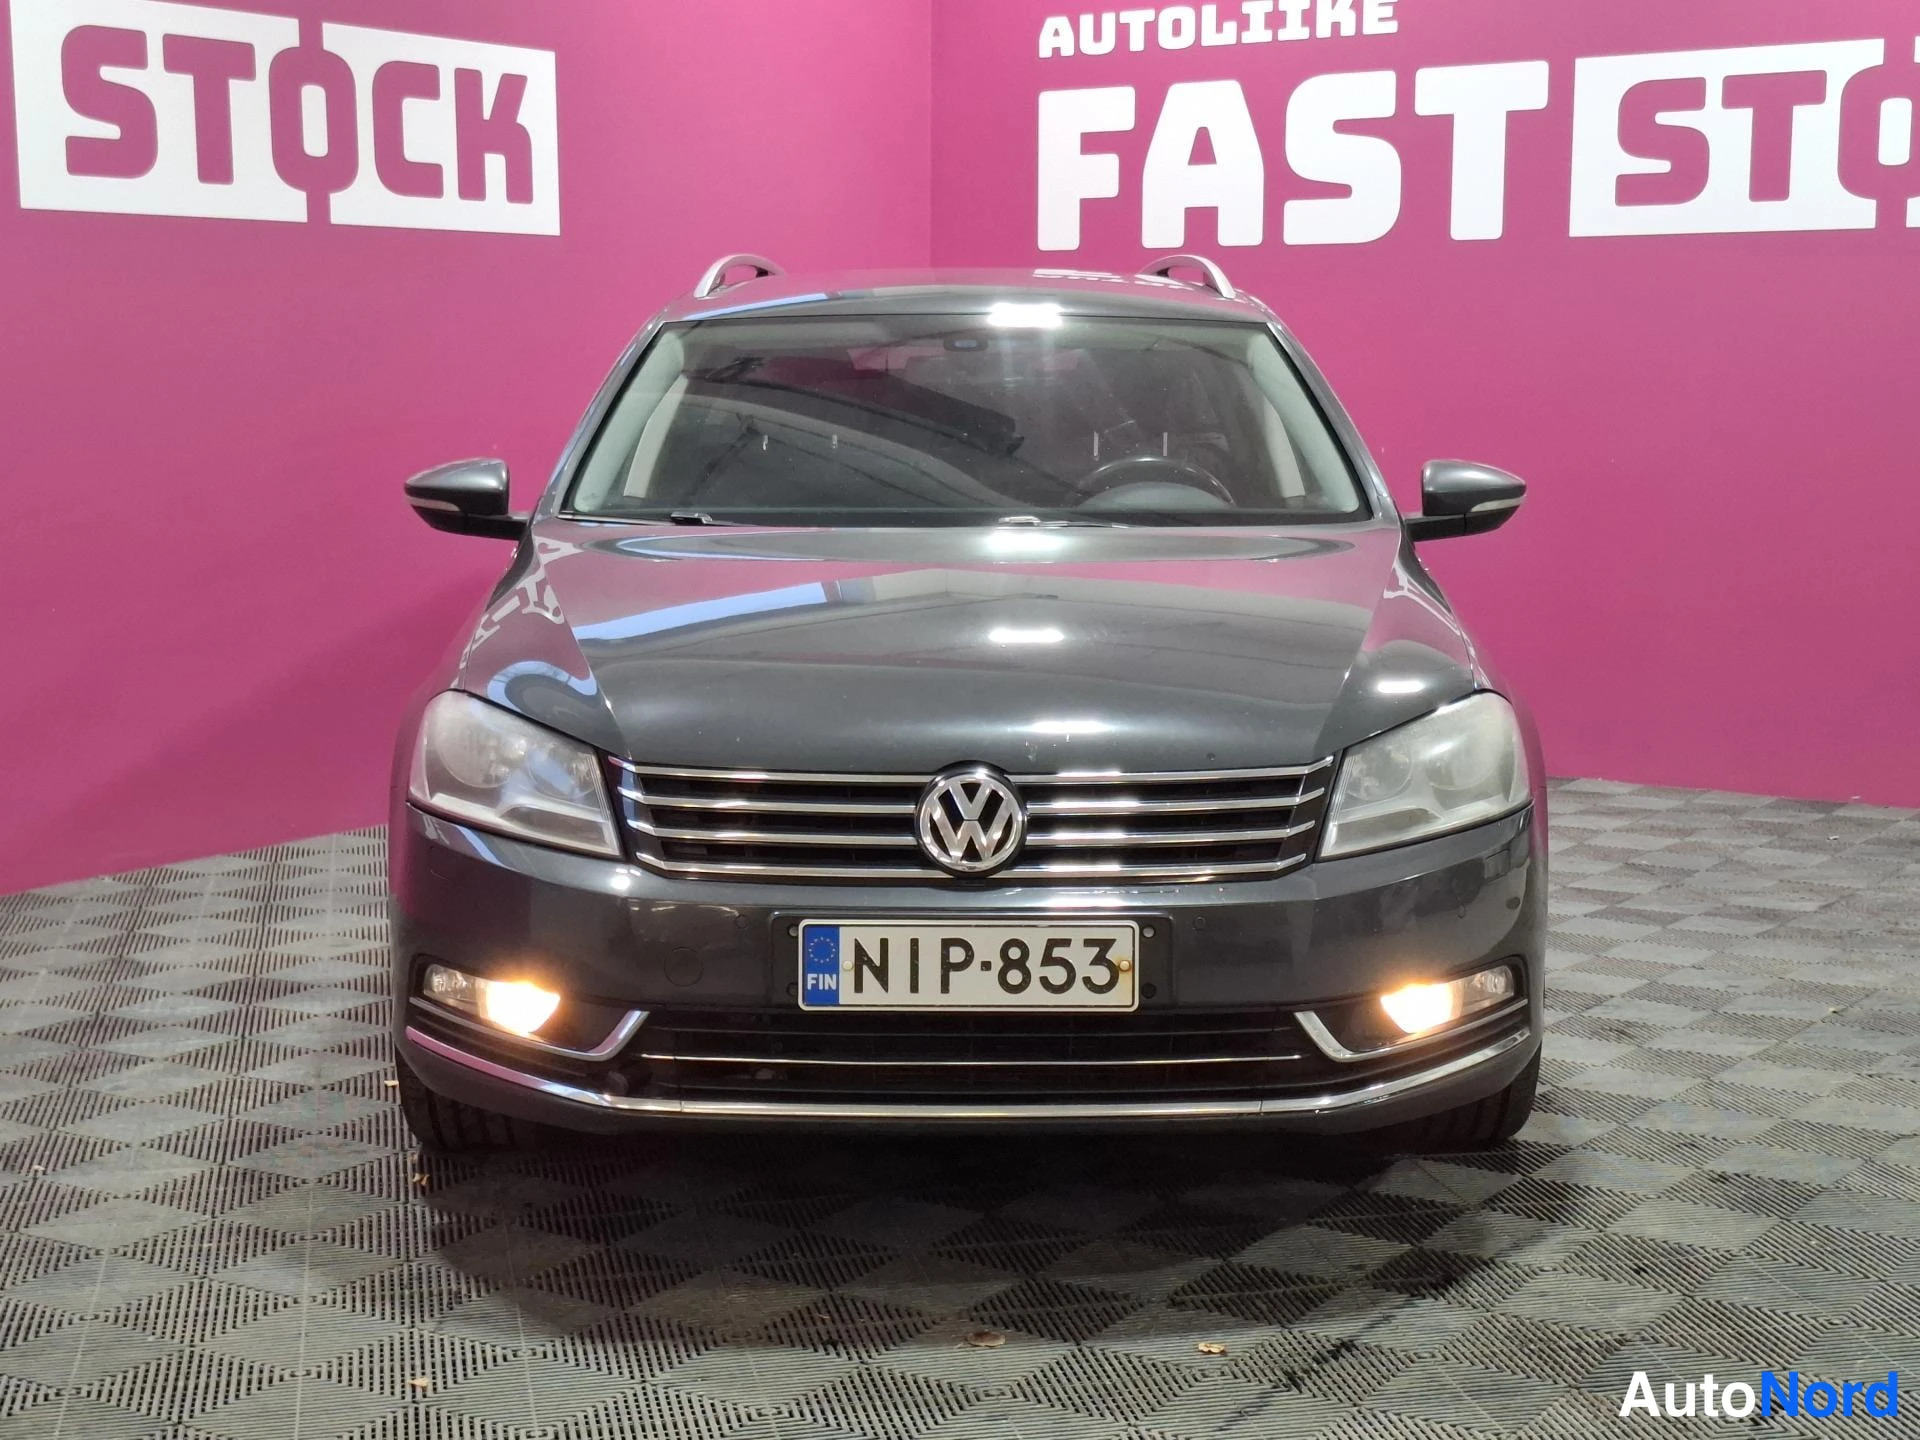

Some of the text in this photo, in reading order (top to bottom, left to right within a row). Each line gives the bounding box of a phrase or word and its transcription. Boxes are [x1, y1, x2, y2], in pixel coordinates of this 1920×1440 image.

[1038, 0, 1399, 58] AUTOLIIKE
[61, 24, 533, 204] STOCK
[1037, 60, 1549, 251] FAST
[806, 973, 837, 991] FIN
[853, 937, 1120, 995] NIP-853
